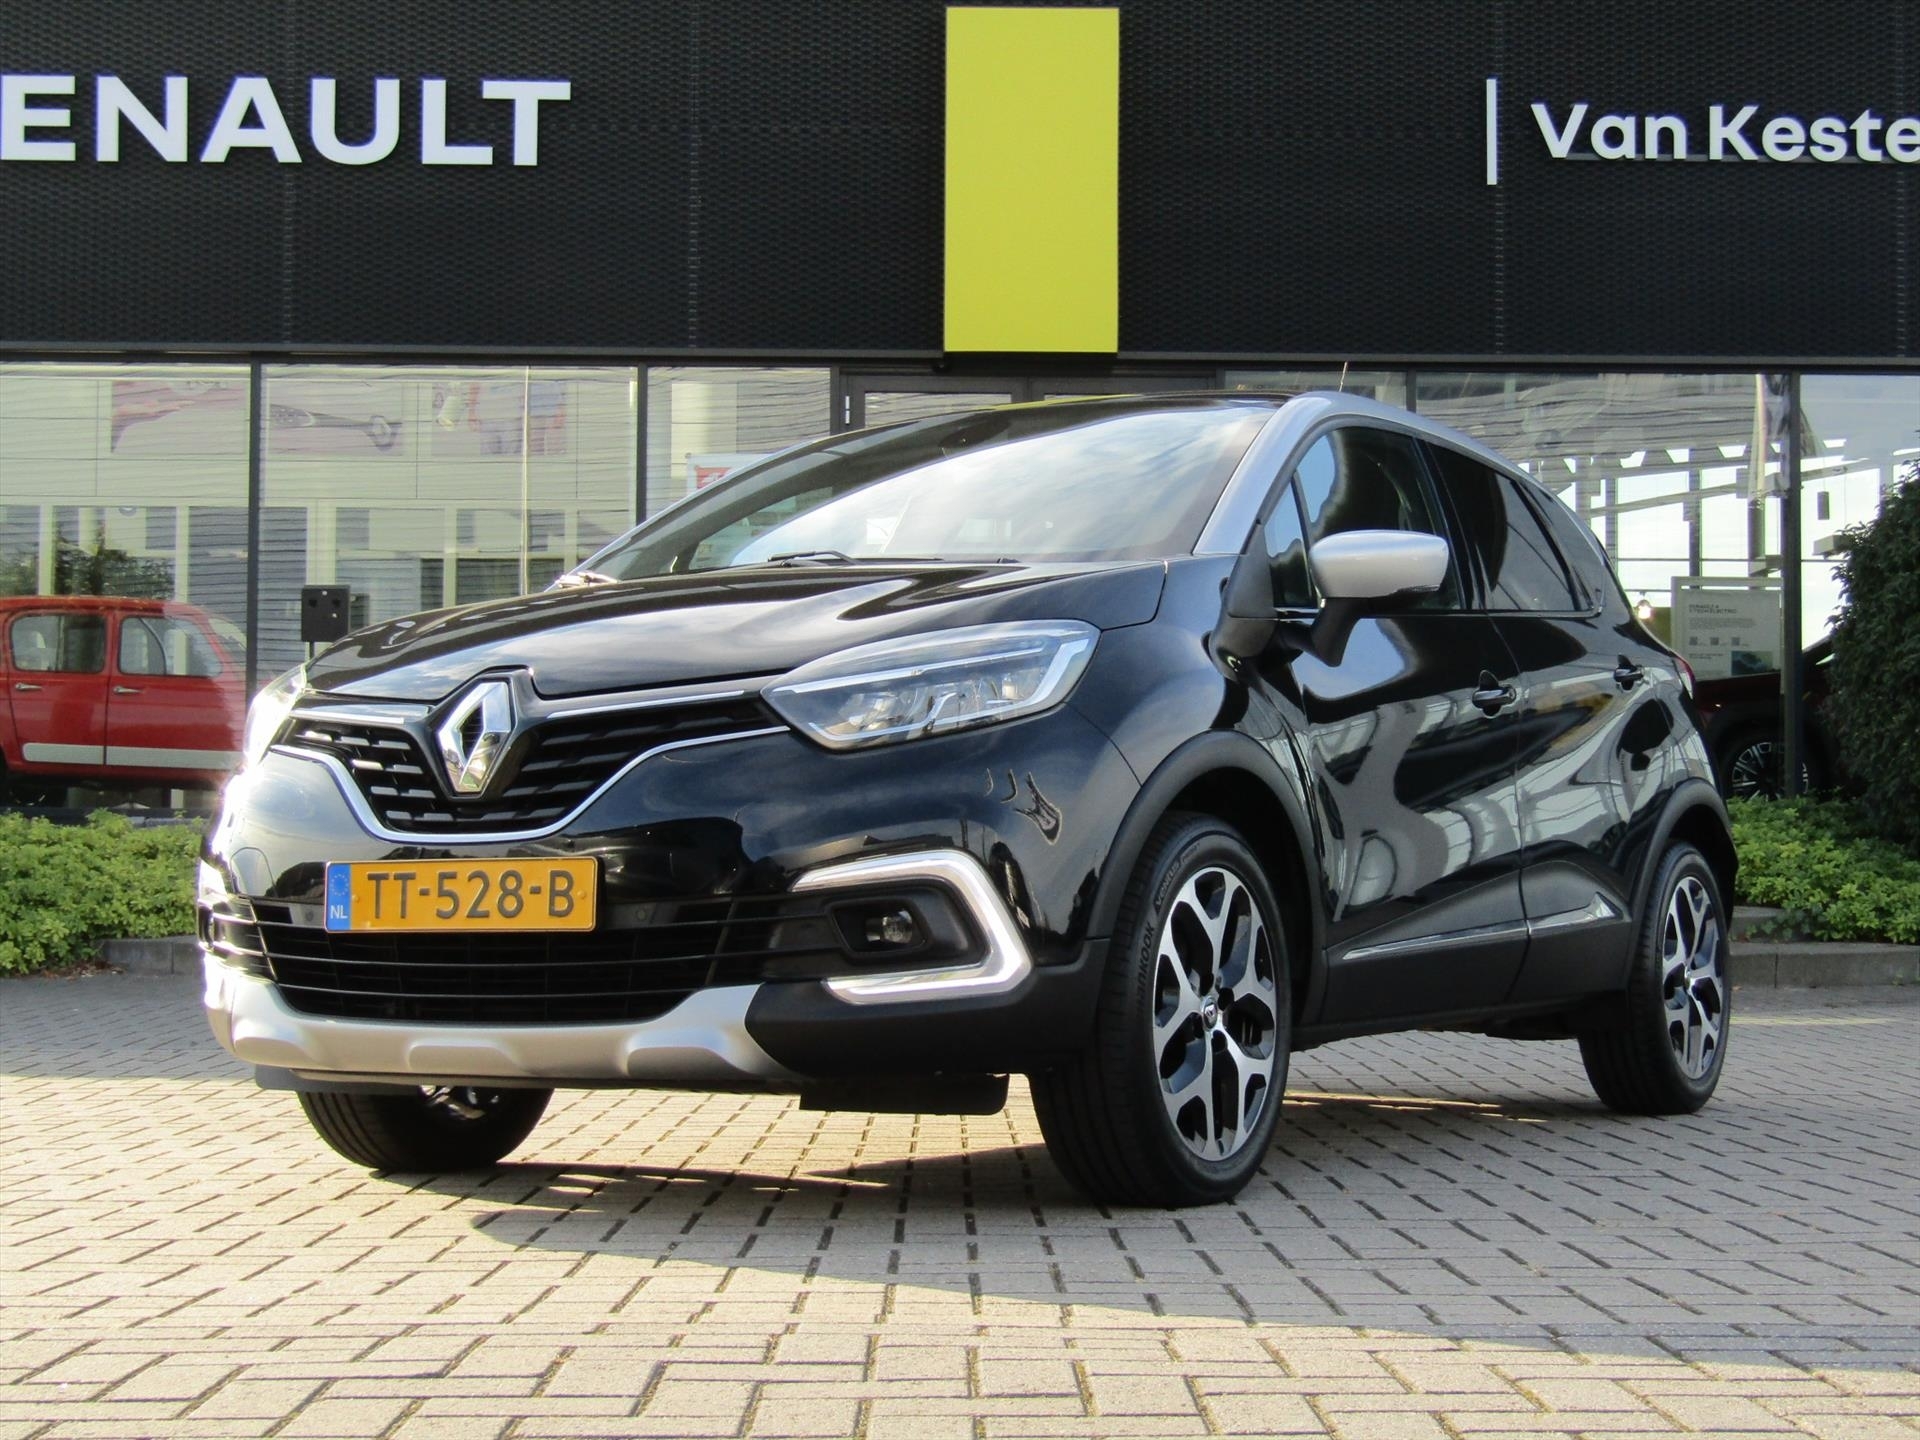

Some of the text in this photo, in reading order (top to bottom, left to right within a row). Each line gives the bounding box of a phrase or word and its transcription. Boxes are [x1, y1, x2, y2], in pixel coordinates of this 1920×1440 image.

[0, 75, 571, 166] ENAULT
[1531, 103, 1920, 163] Van Keste
[330, 904, 348, 919] NL
[367, 869, 575, 919] TT-528-B
